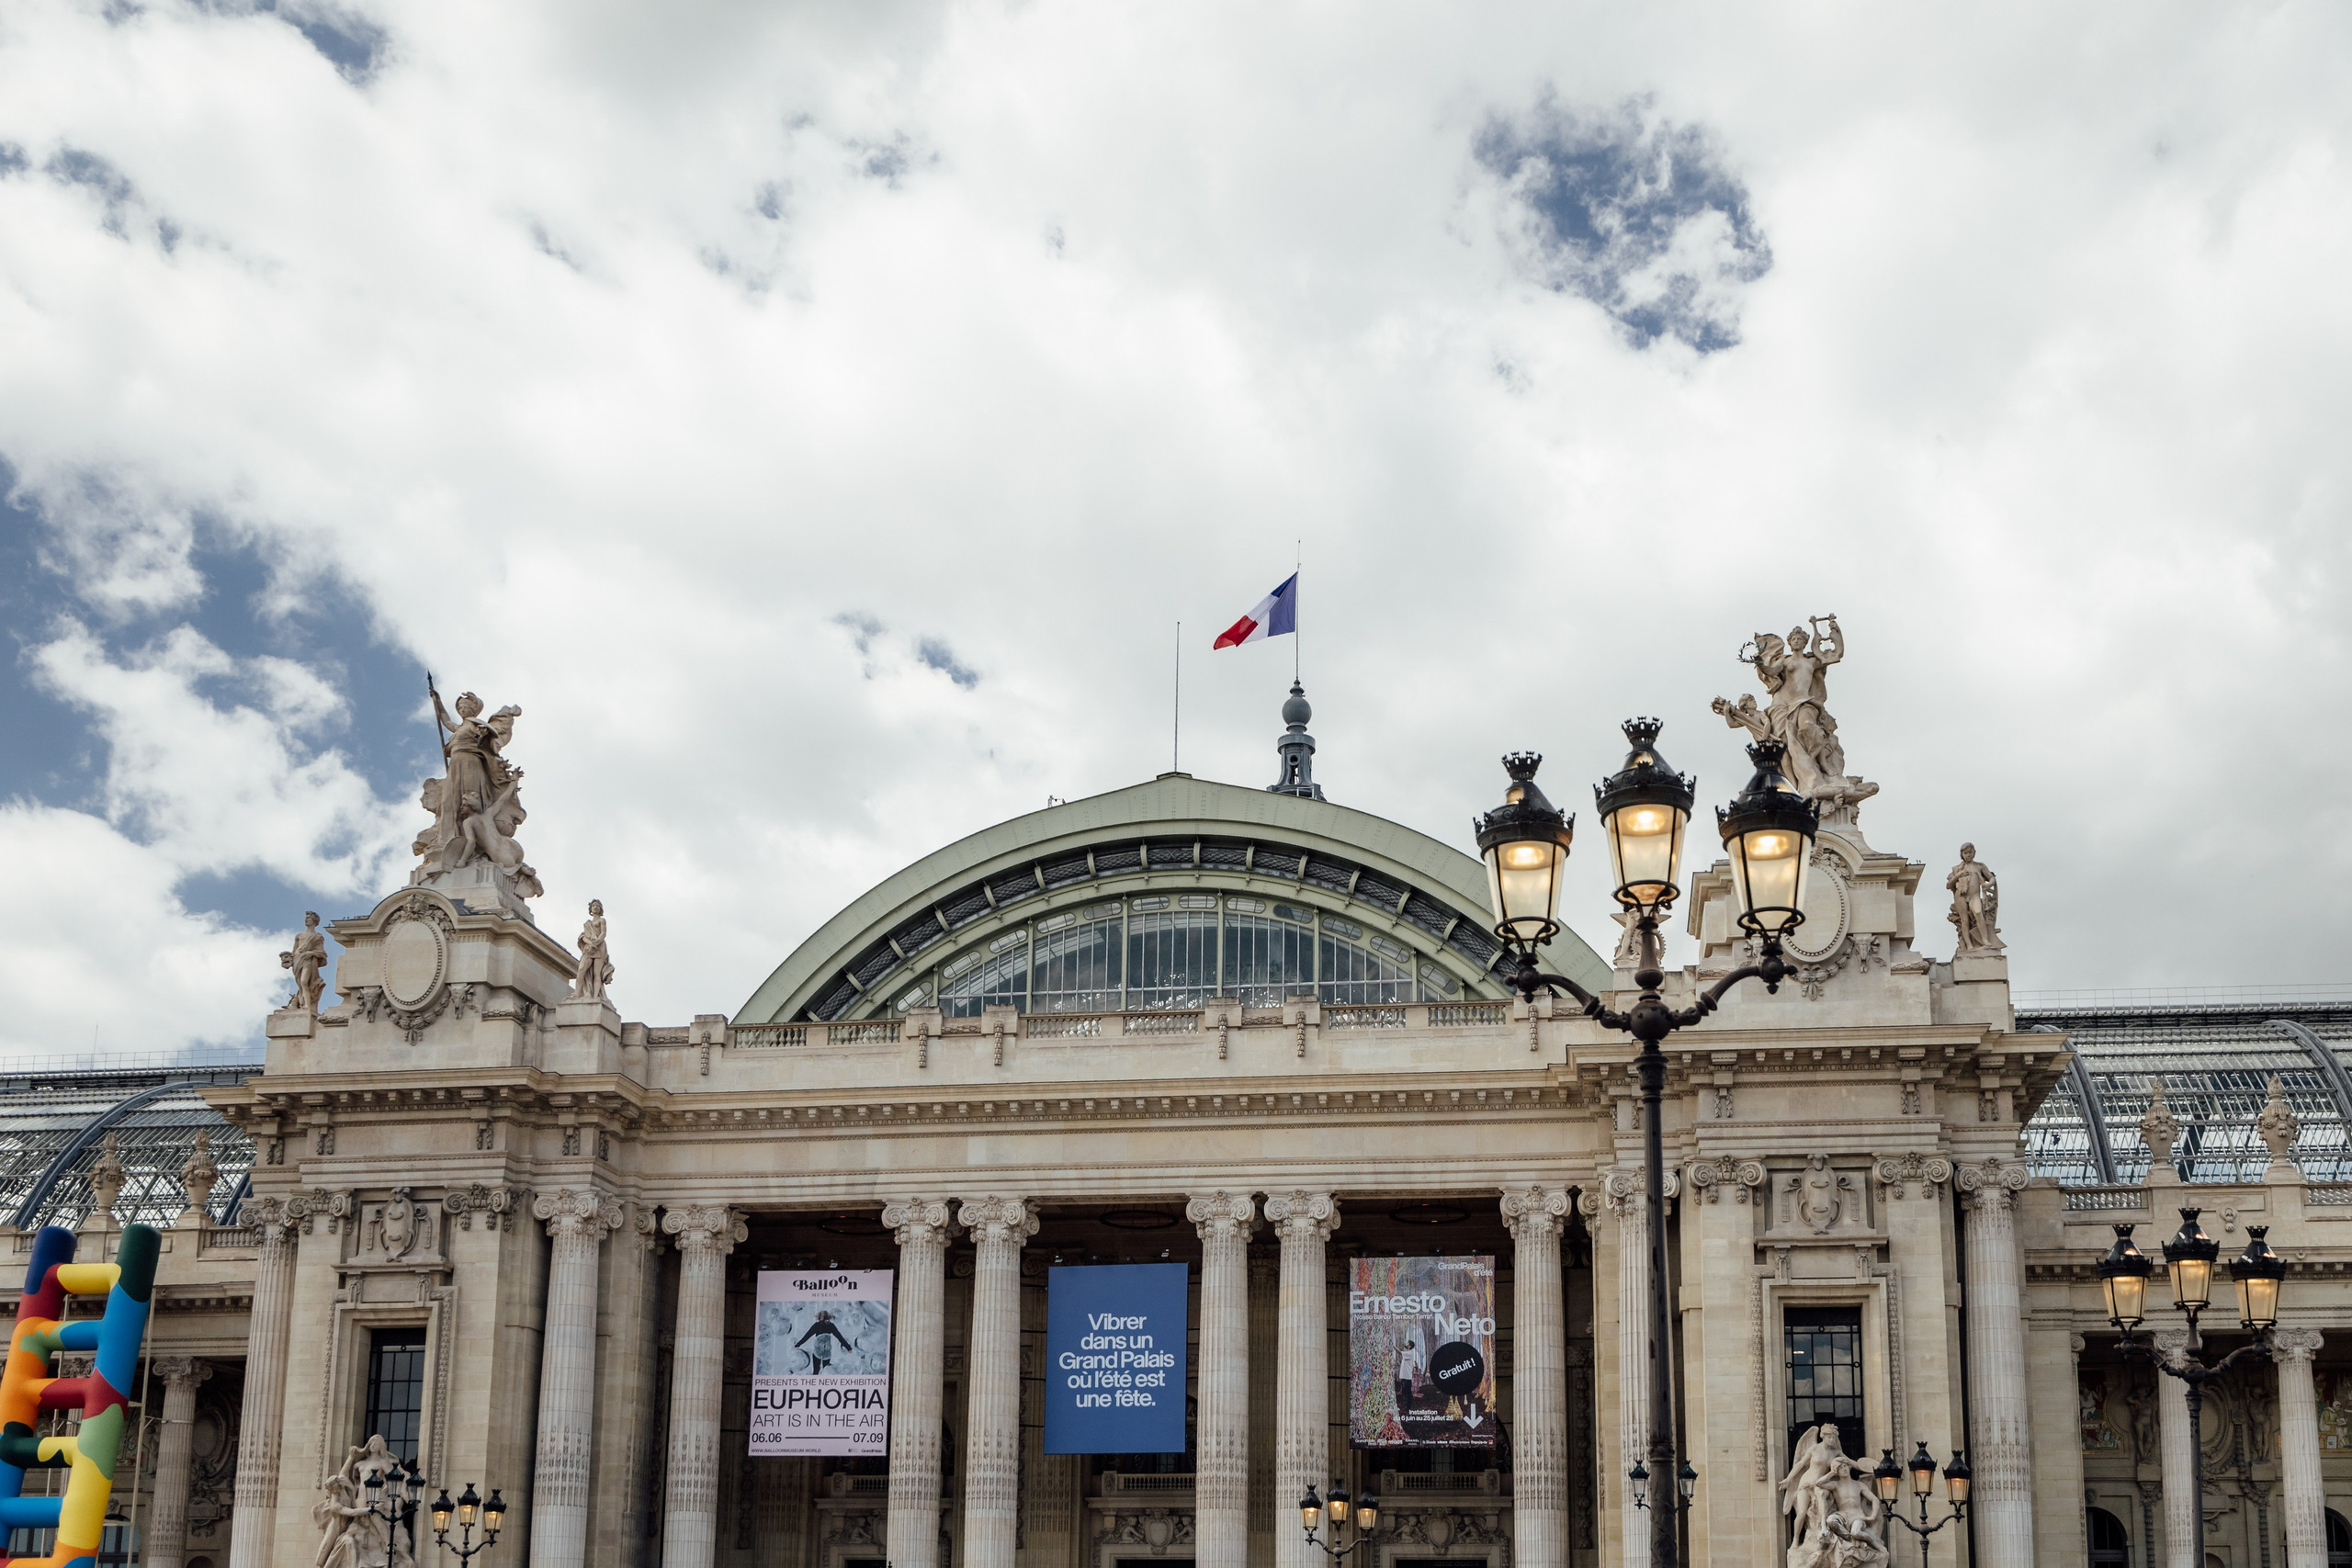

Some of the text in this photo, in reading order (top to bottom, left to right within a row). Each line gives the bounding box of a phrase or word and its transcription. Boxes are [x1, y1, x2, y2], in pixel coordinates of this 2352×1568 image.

[1438, 1261, 1485, 1270] GrandPalais
[792, 1275, 858, 1291] Balloon
[1350, 1291, 1446, 1314] Ernesto
[1088, 1313, 1148, 1331] Vibrer
[1434, 1313, 1496, 1336] Neto
[1080, 1332, 1153, 1350] dans un
[1058, 1349, 1175, 1370] Grand Palais
[1438, 1359, 1473, 1380] Gratuit
[754, 1378, 887, 1386] PRESENTS THE NEW EXHIBITION
[1067, 1370, 1166, 1389] où l'été est
[1076, 1389, 1156, 1408] une fête.
[752, 1414, 885, 1427] ART IS IN THE AIR
[1406, 1415, 1415, 1423] juin
[1431, 1415, 1445, 1423] juillet
[752, 1432, 884, 1443] 06.06 07.09
